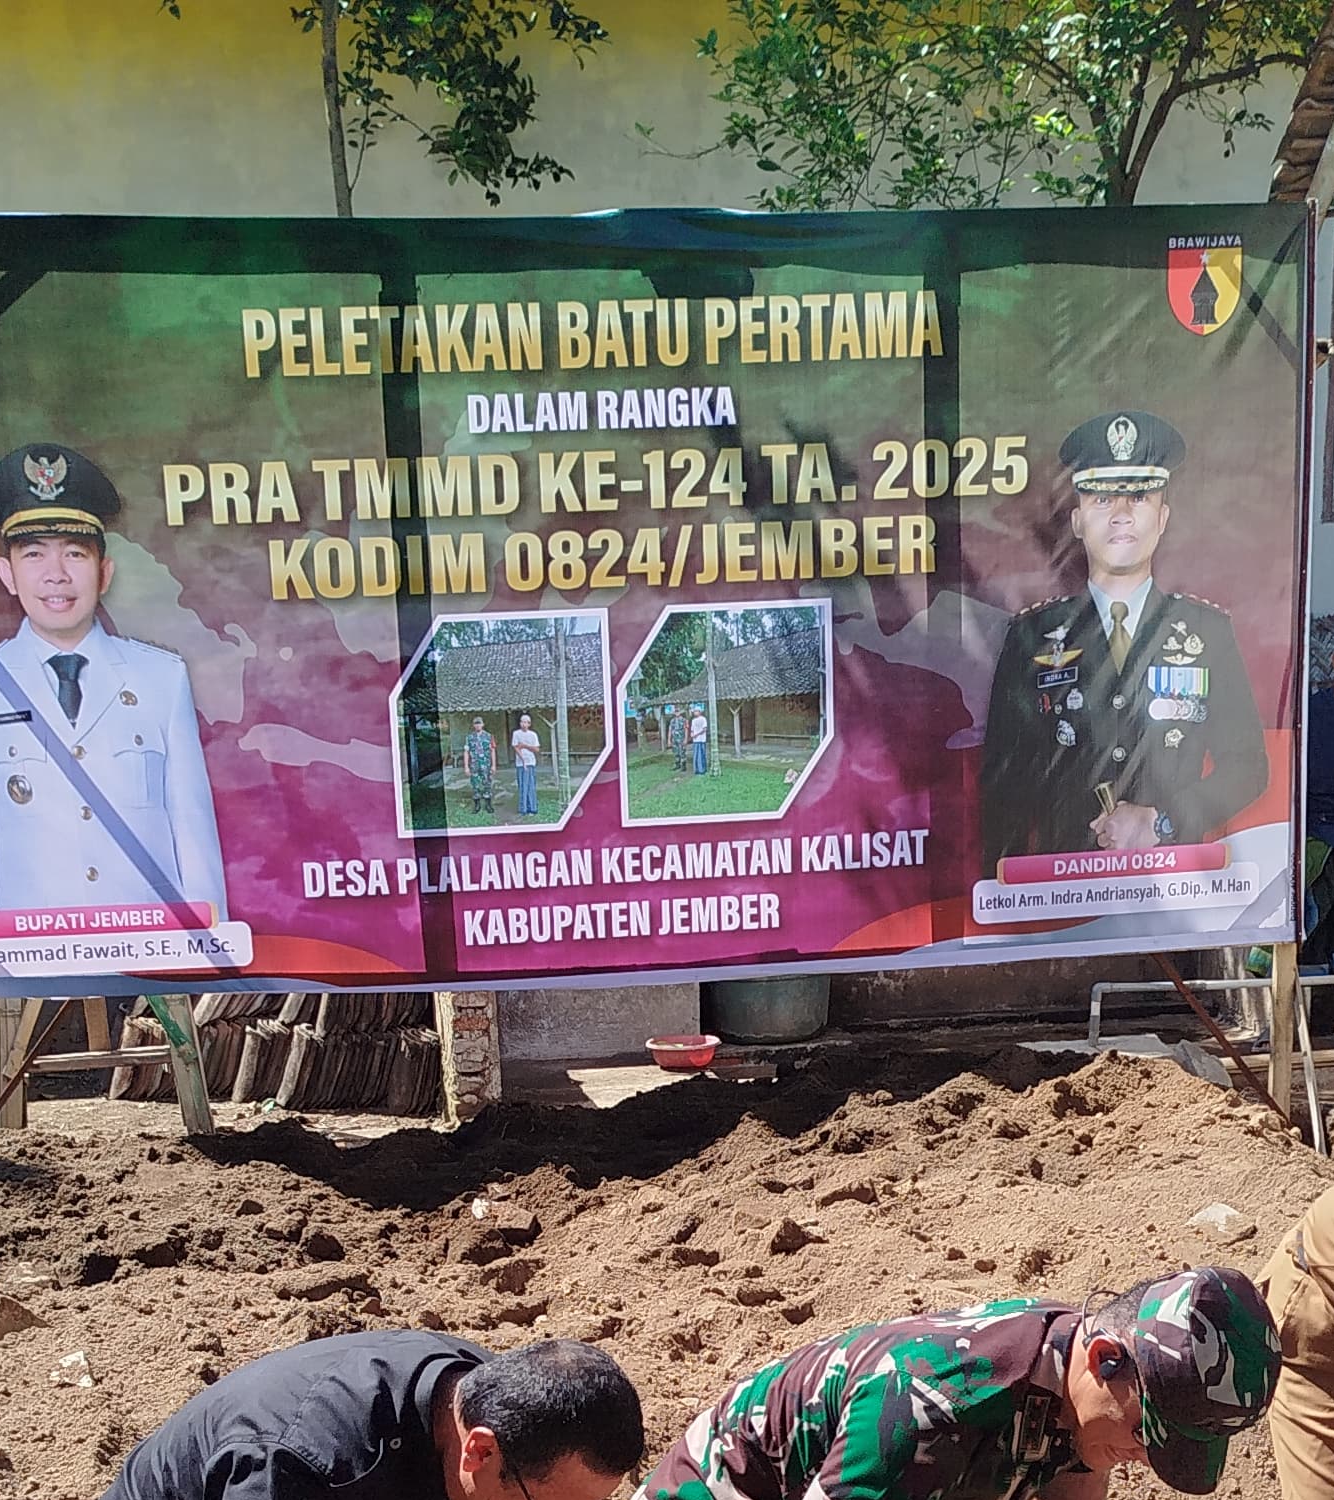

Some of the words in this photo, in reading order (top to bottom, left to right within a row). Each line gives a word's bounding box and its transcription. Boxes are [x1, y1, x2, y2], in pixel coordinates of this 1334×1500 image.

[1168, 233, 1242, 249] BRAWIJAYA
[242, 302, 543, 378] PELETAKAN
[557, 297, 689, 369] BATU
[704, 290, 943, 365] PERTAMA
[467, 391, 588, 434] DALAM
[597, 386, 737, 430] RANGKA
[162, 461, 300, 526] PRA
[312, 454, 520, 522] TMMD
[538, 447, 748, 514] KE-124
[761, 442, 857, 504] TA.
[872, 435, 1029, 500] 2025
[268, 532, 487, 601] KODIM
[505, 514, 937, 592] 0824/JEMBER
[302, 859, 390, 898] DESA
[397, 848, 593, 895] PLALANGAN
[602, 837, 792, 885] KECAMATAN
[801, 829, 930, 873] KALISAT
[1054, 855, 1128, 876] DANDIM
[1131, 852, 1177, 870] 0824
[979, 892, 1016, 911] Letkol
[1018, 891, 1048, 908] Arm.
[1051, 888, 1082, 904] Indra
[1085, 883, 1165, 905] Andriansyah,
[1167, 881, 1208, 899] G.Dip.,
[1211, 878, 1251, 894] M.Han
[15, 912, 86, 932] BUPATI
[89, 909, 165, 929] JEMBER
[463, 900, 651, 947] KABUPATEN
[658, 893, 780, 936] JEMBER
[73, 941, 139, 961] Fawait,
[145, 940, 182, 958] S.E.,
[187, 937, 236, 955] M.Sc.
